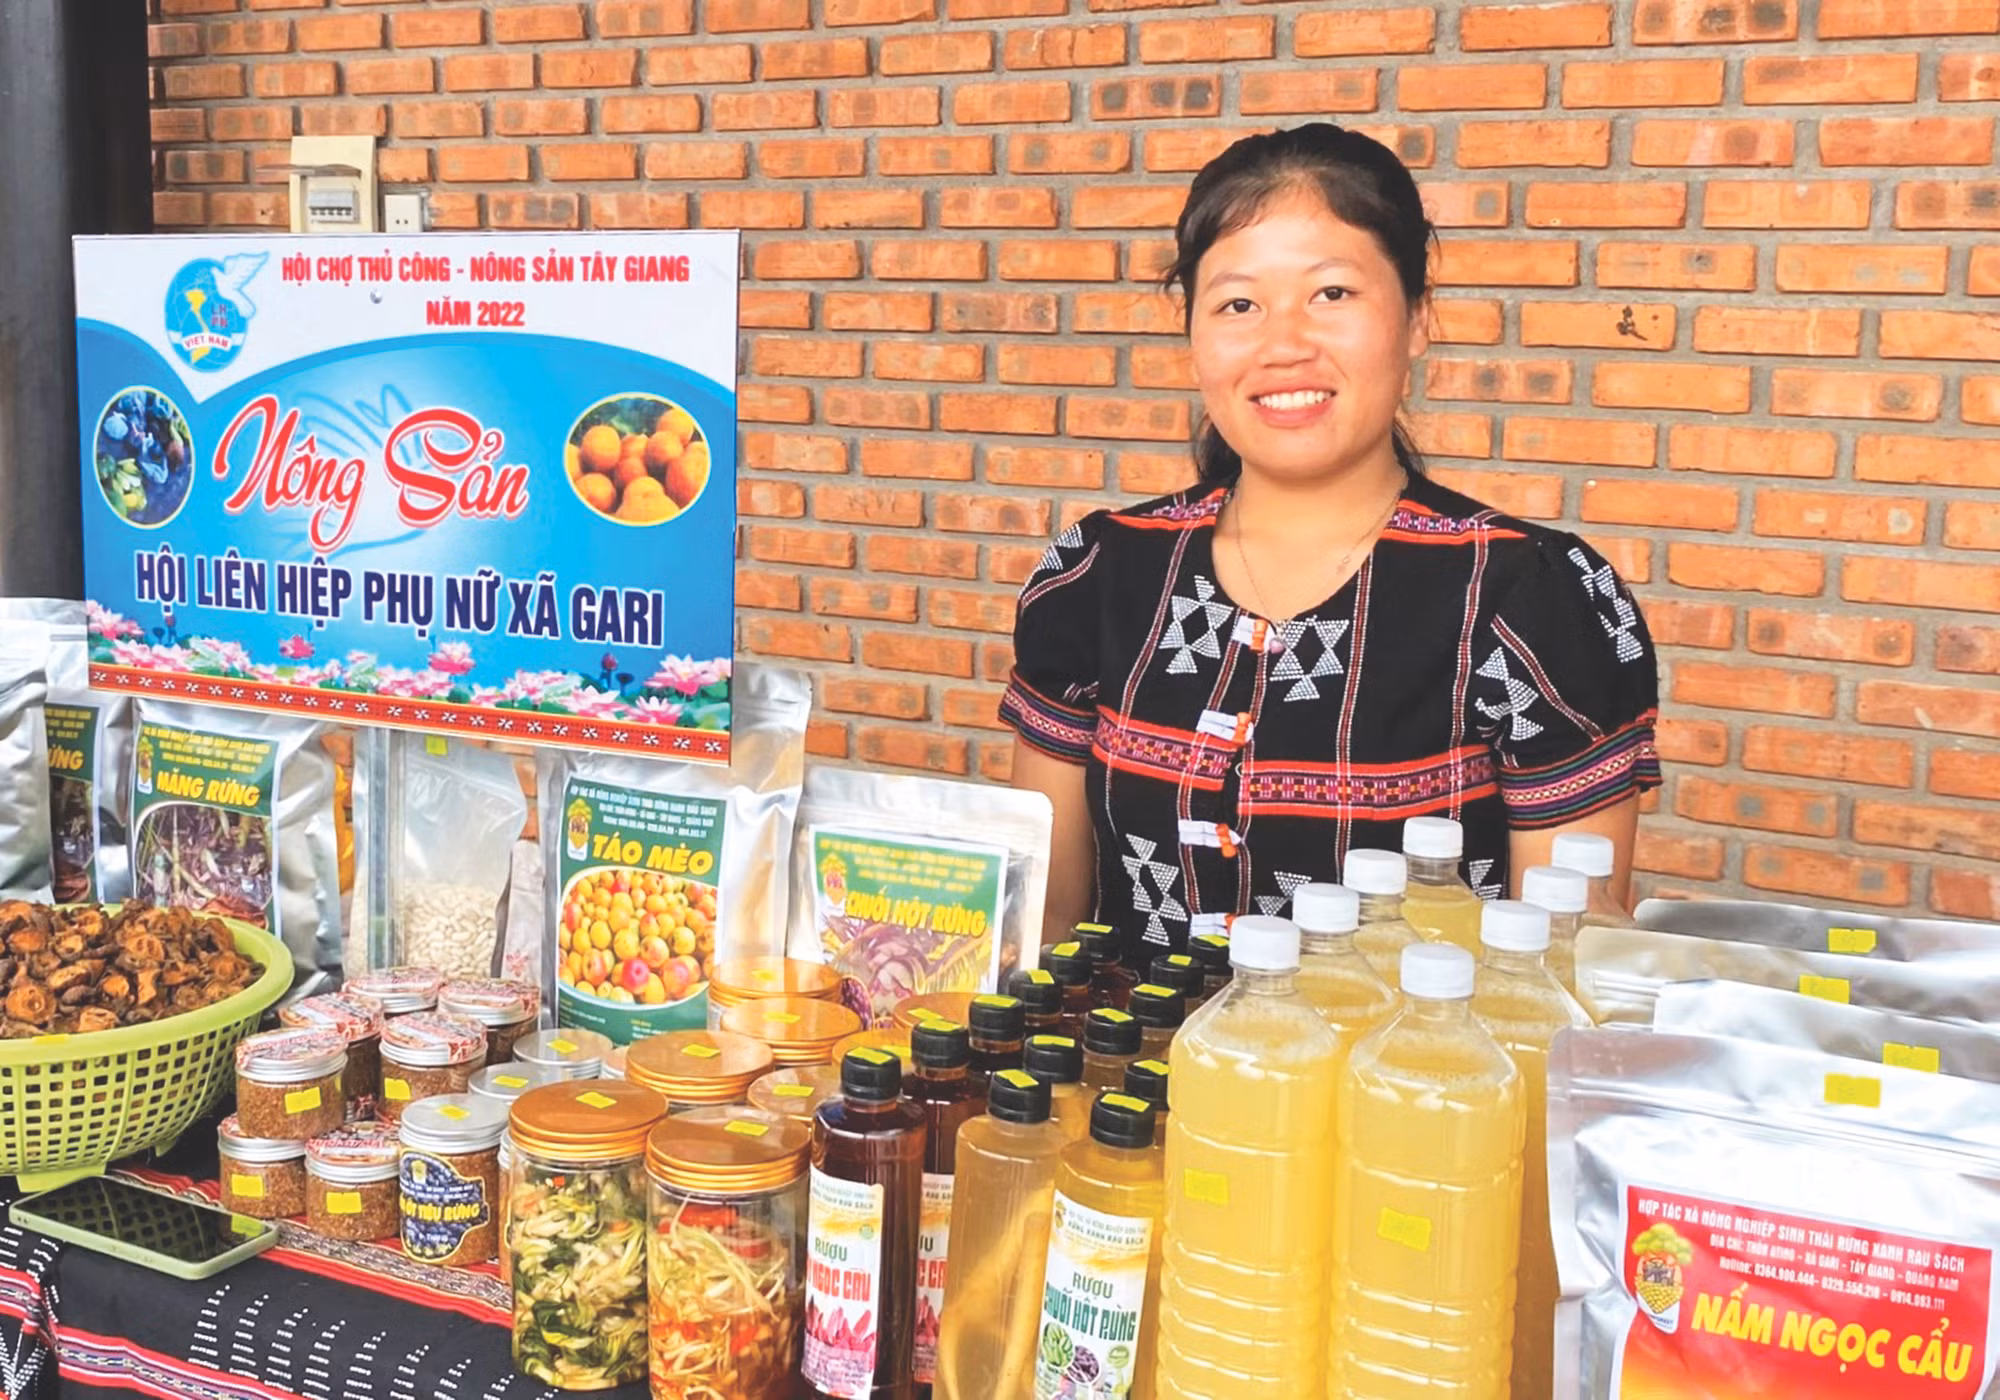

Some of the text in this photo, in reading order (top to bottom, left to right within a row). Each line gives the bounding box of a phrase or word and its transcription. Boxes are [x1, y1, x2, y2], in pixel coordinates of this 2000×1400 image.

[282, 252, 311, 287] HỘI
[317, 254, 353, 287] CHỢ
[358, 248, 392, 282] THỦ
[399, 251, 450, 282] CÔNG
[470, 251, 526, 282] NÔNG
[532, 248, 574, 282] SẢN
[580, 250, 618, 282] TÂY
[624, 255, 690, 282] GIANG
[426, 295, 526, 326] NĂM 2022
[208, 335, 229, 349] NAM
[213, 395, 529, 552] Nông Sản
[137, 546, 663, 647] HỘI LIÊN HIỆP PHỤ NỮ XÃ GARI
[48, 744, 84, 770] ỪNG
[157, 767, 261, 807] MĂNG RỪNG
[592, 832, 714, 875] TÁO MÈO
[931, 901, 986, 938] RỪNG
[815, 1236, 847, 1263] RƯỢU
[1662, 1201, 1681, 1220] TÁC
[1778, 1225, 1805, 1244] SINH
[1872, 1241, 1904, 1262] XANH
[1907, 1248, 1930, 1268] RAU
[1072, 1271, 1113, 1300] RƯỢU
[1691, 1282, 1974, 1383] NẤM NGỌC CẨU
